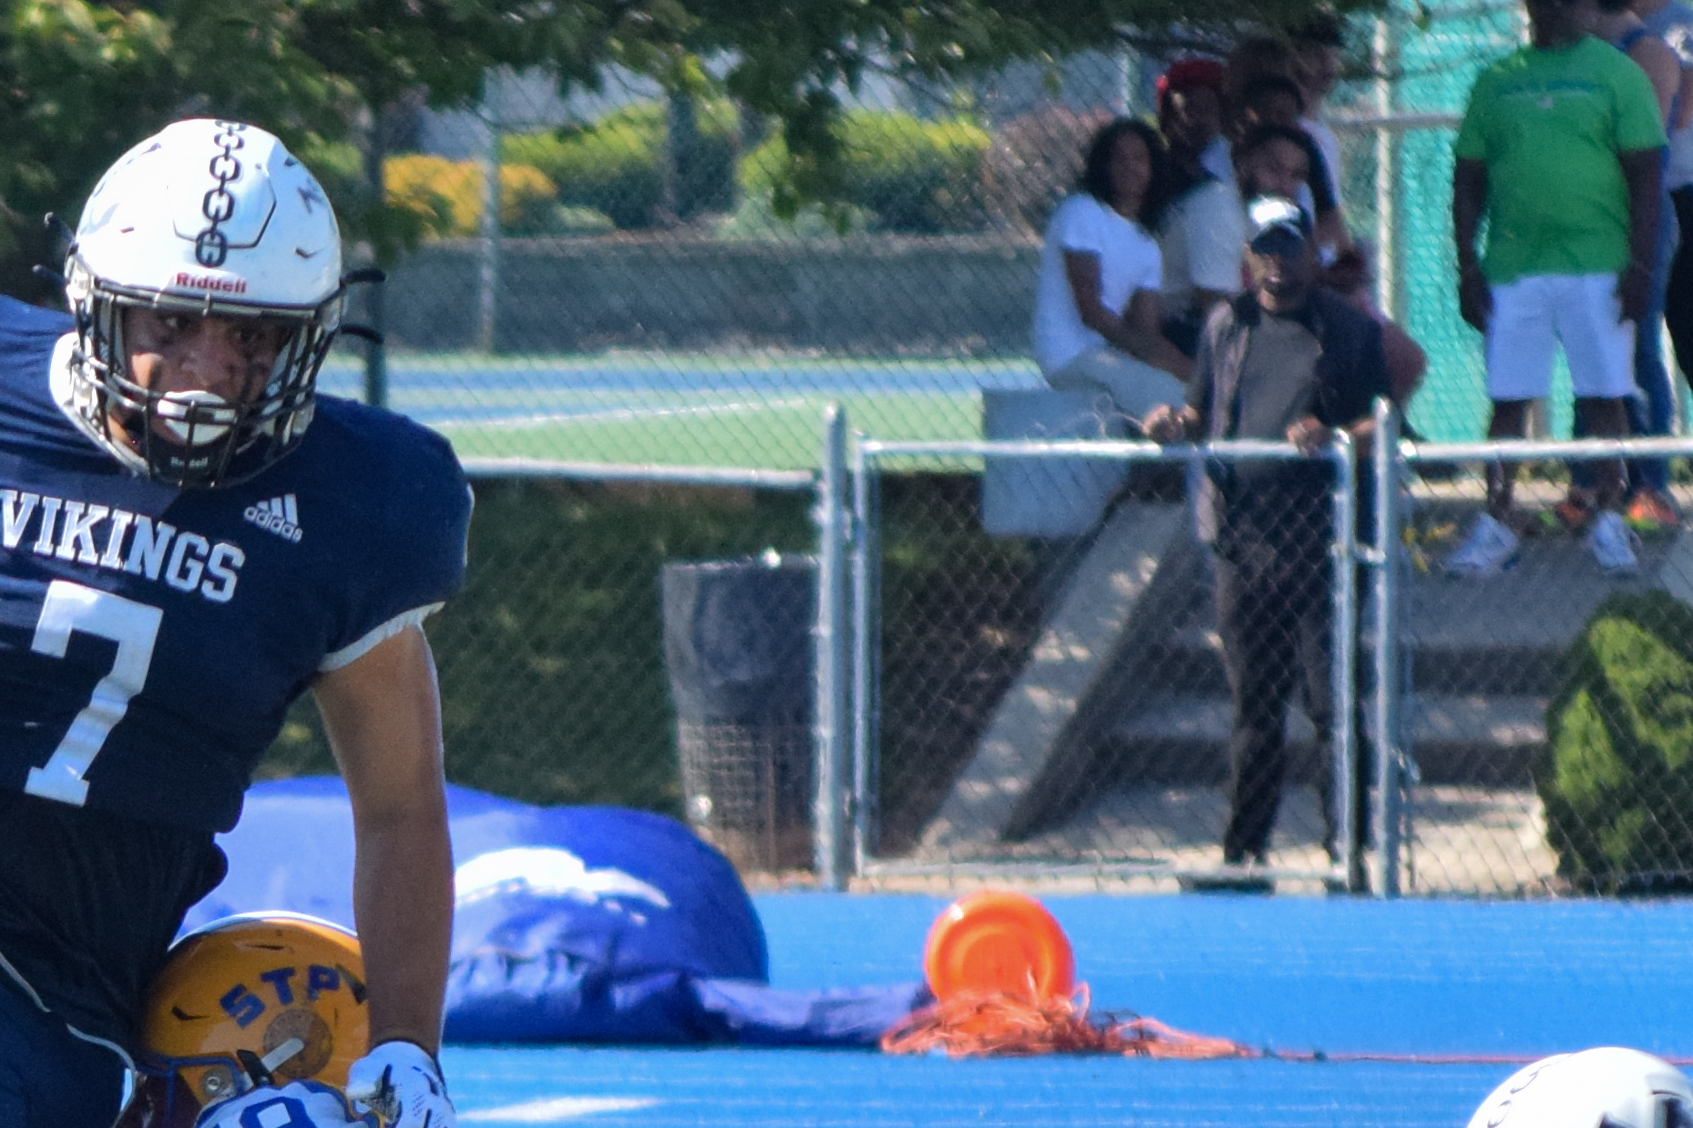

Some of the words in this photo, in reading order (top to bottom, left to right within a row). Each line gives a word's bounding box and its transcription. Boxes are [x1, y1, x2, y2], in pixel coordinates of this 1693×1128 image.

[176, 271, 247, 293] Riddell
[243, 506, 304, 543] adidas
[24, 579, 164, 807] 7
